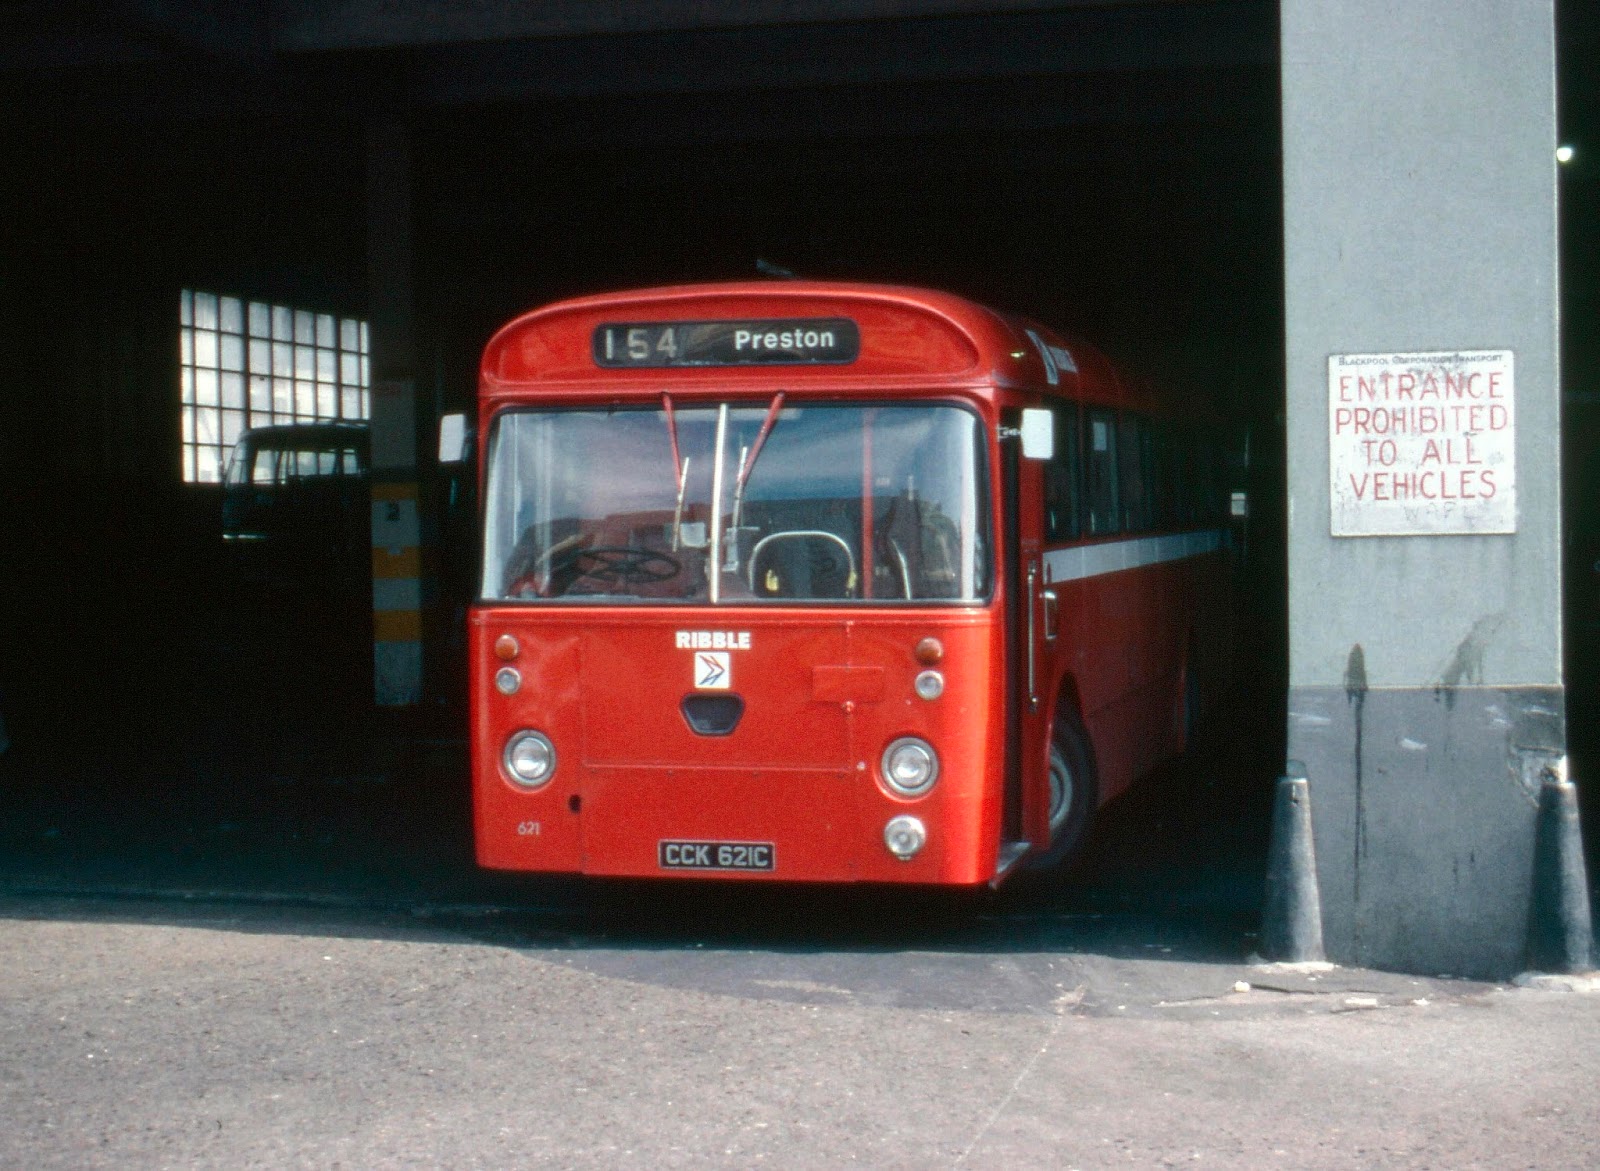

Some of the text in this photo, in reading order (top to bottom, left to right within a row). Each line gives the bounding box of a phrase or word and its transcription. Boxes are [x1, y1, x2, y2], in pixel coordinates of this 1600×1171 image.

[605, 328, 834, 359] 154 Preston
[1339, 372, 1504, 402] ENTRANCE
[1335, 405, 1508, 435] PROHIBITED
[1362, 438, 1482, 466] TO ALL
[1350, 470, 1496, 501] VEHICLES
[675, 631, 752, 650] RIBBLE
[517, 821, 540, 835] 621
[665, 844, 768, 867] CCK 621C
